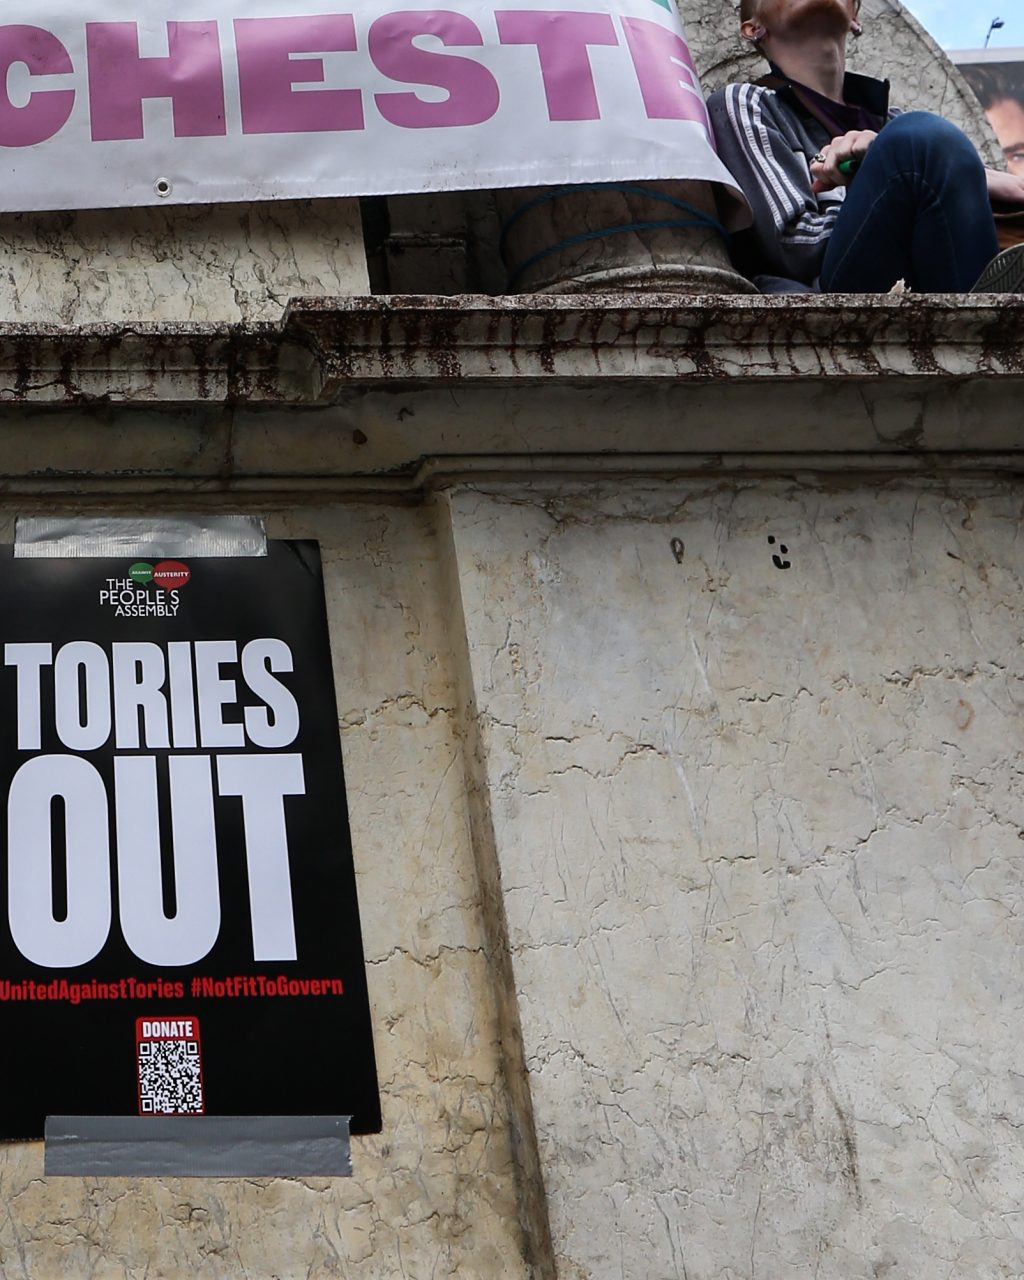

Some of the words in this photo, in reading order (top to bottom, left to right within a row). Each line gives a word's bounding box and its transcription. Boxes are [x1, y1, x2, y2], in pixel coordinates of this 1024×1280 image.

[106, 578, 133, 590] THE
[114, 605, 180, 617] ASSEMBLY
[4, 638, 300, 750] TORIES
[7, 753, 306, 968] OUT
[191, 976, 344, 998] #NotFitToGovern
[142, 1021, 193, 1038] DONATE
